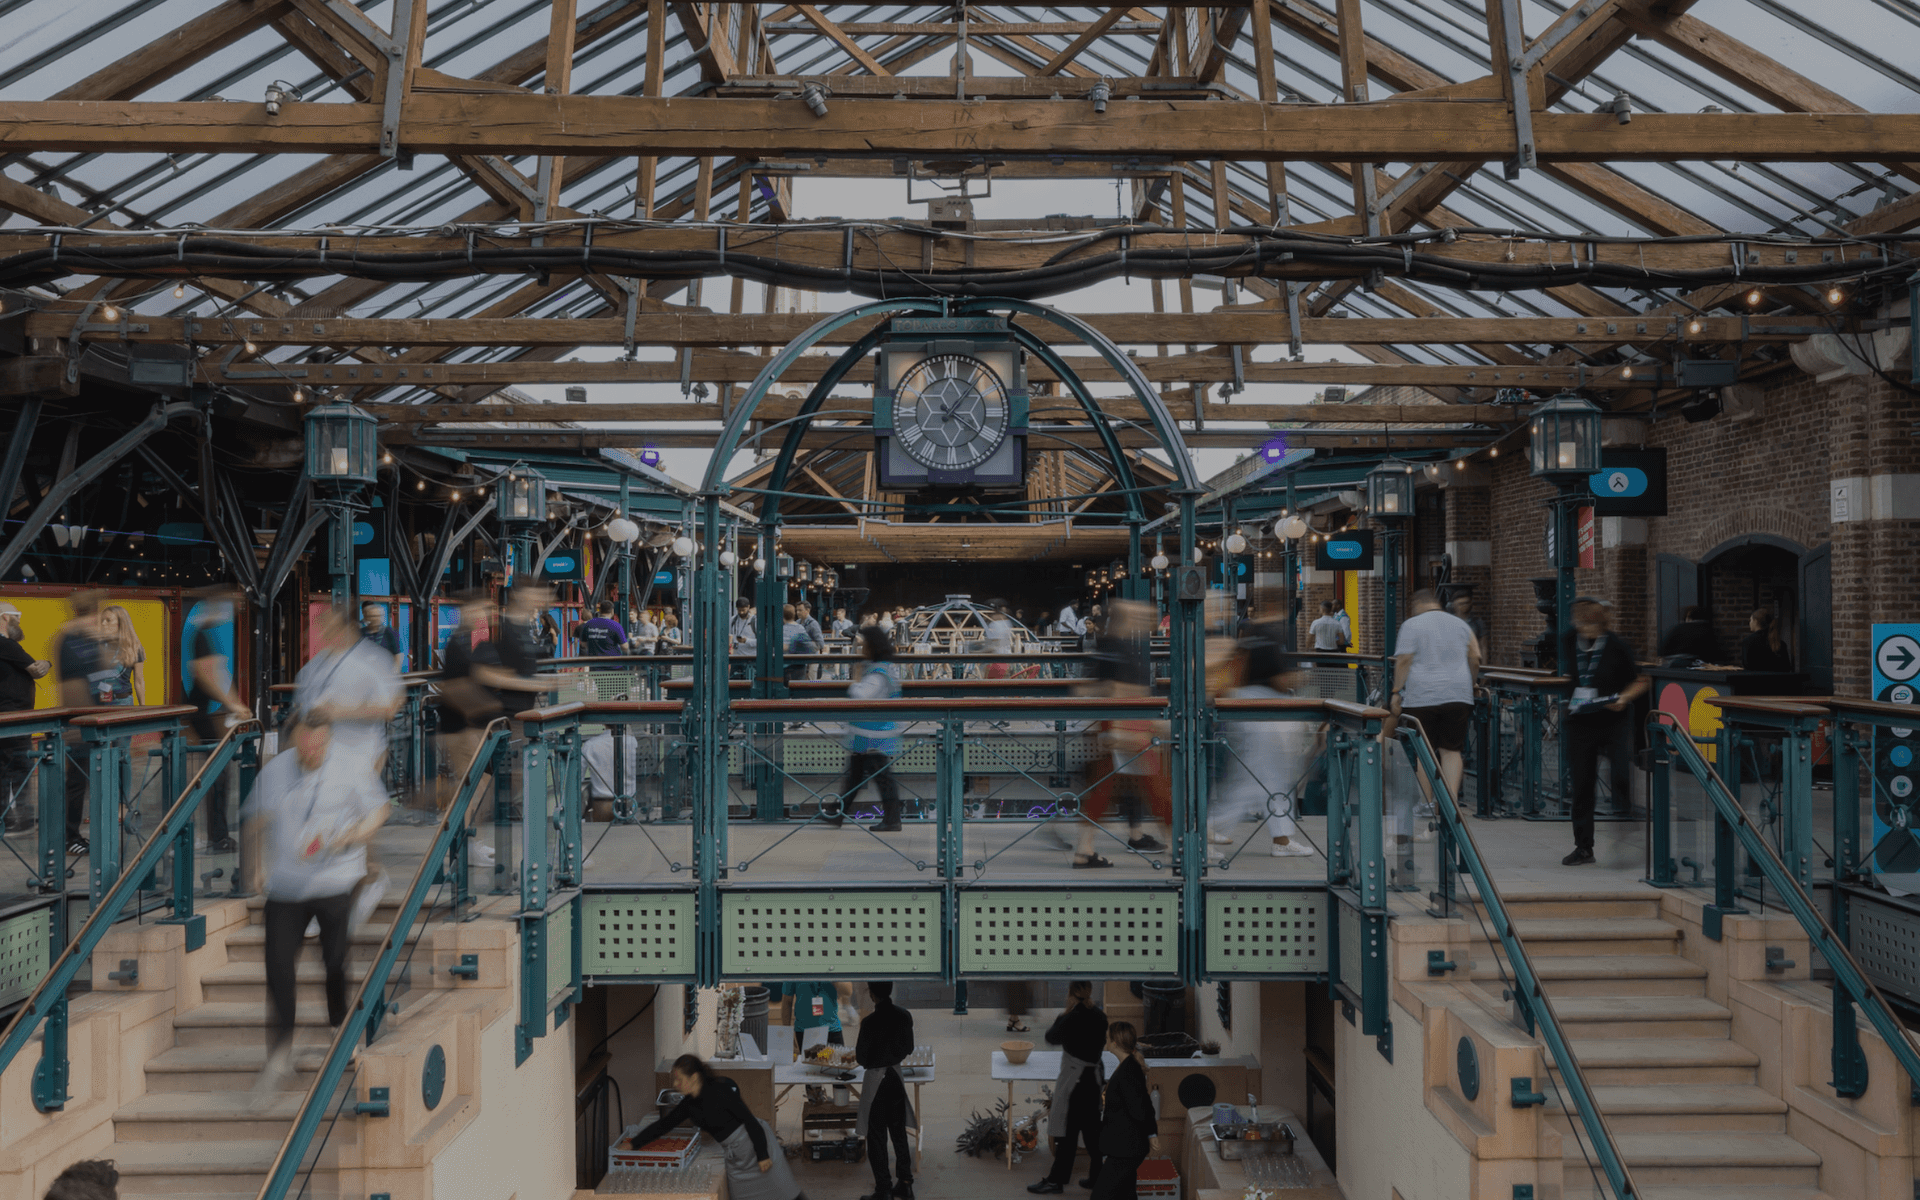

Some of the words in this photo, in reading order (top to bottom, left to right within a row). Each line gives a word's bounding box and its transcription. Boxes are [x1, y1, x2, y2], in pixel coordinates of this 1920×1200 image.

[894, 320, 958, 331] TOBACCO
[964, 320, 1004, 331] DOCK
[943, 360, 958, 379] XII
[985, 407, 1004, 418] III
